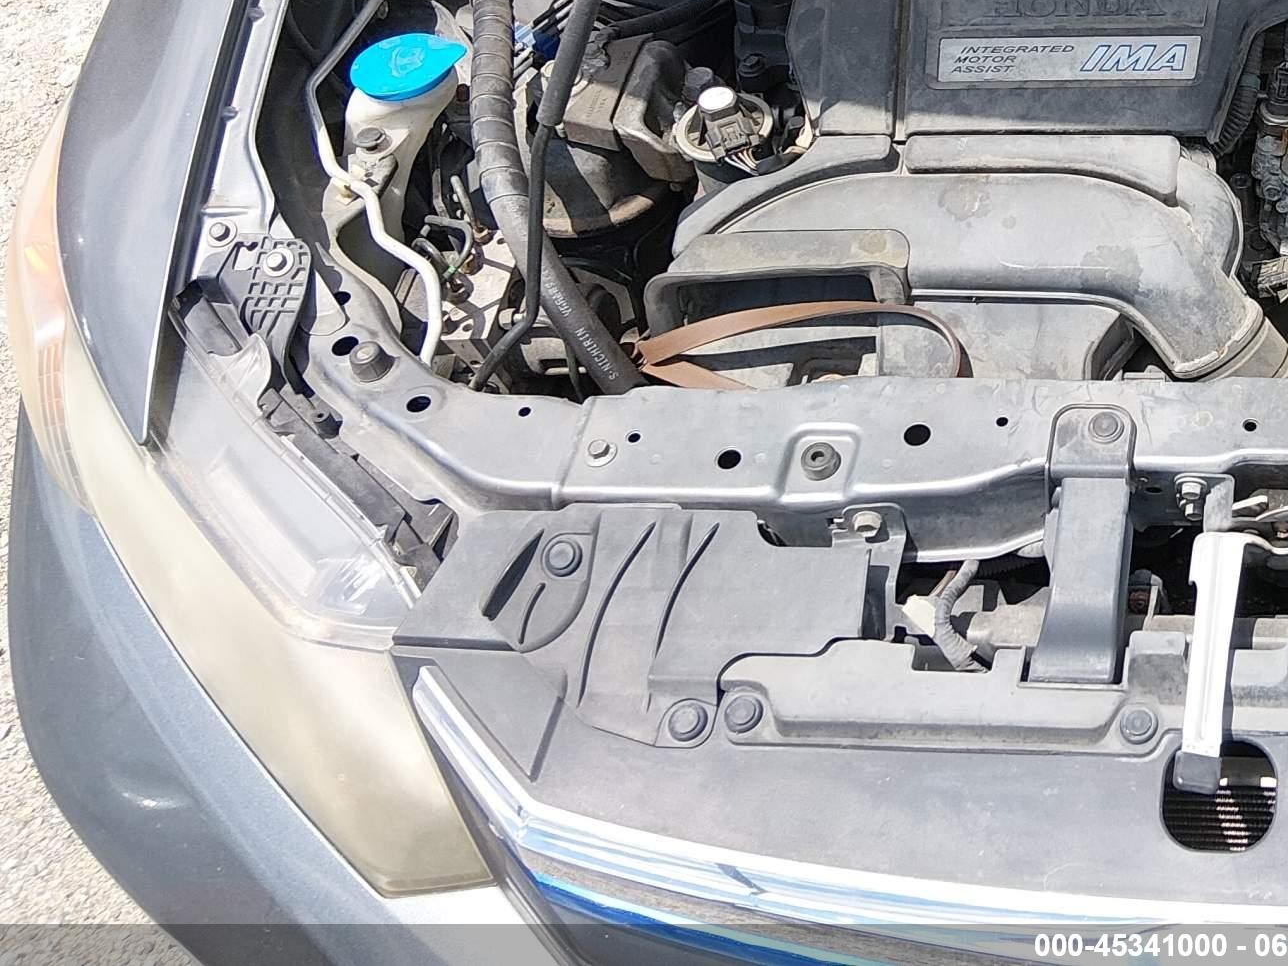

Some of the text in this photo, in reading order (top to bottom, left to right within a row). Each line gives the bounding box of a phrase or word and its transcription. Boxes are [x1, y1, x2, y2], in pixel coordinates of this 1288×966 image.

[960, 44, 1075, 55] INTEGRATED
[953, 54, 1017, 64] MOTOR
[1079, 43, 1188, 72] IMA
[951, 65, 1015, 74] ASSIST
